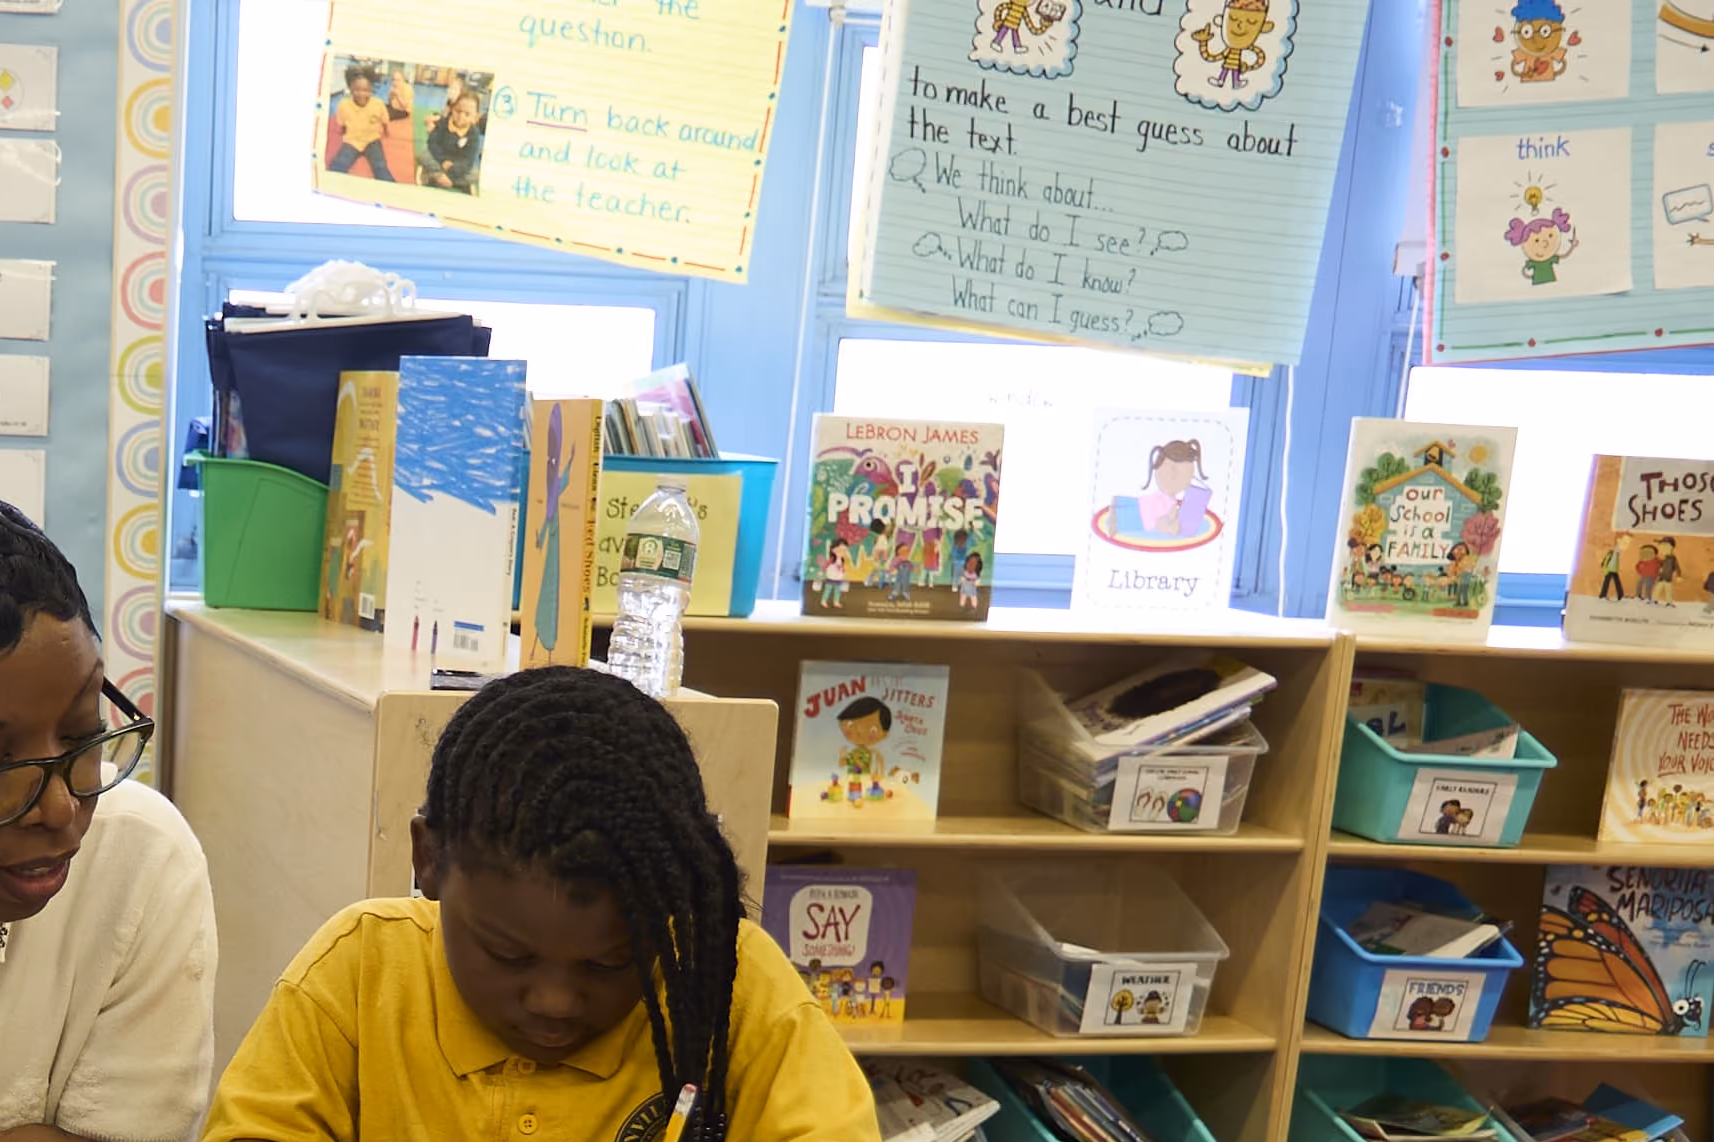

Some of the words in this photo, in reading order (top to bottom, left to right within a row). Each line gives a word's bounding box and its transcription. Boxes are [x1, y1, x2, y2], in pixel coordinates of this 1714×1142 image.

[527, 89, 588, 125] Turn
[607, 105, 670, 137] back
[678, 122, 759, 153] around
[908, 65, 938, 100] to
[946, 82, 1009, 115] make
[1033, 101, 1049, 121] a
[1067, 92, 1121, 134] best
[1137, 117, 1204, 153] guess
[1227, 119, 1300, 157] about
[908, 106, 950, 145] the
[519, 137, 571, 165] and
[586, 146, 639, 176] look
[653, 155, 686, 182] at
[1516, 136, 1571, 160] think
[511, 175, 557, 203] the
[934, 152, 962, 190] We
[979, 160, 1029, 200] think
[958, 196, 1011, 235] What
[1029, 213, 1051, 242] do
[1063, 213, 1080, 248] I
[1096, 227, 1146, 256] see?
[955, 235, 1006, 275] What
[1015, 252, 1034, 282] do
[1051, 252, 1067, 286] I
[1082, 259, 1137, 296] know?
[952, 276, 995, 313] What
[1007, 296, 1039, 322] can
[1051, 293, 1064, 325] I
[1069, 306, 1135, 334] guess?
[922, 425, 980, 444] JAMES
[898, 464, 918, 494] I
[827, 492, 985, 531] PROMISE
[1389, 494, 1452, 524] School
[1628, 493, 1704, 528] SHOES
[1403, 525, 1417, 537] is
[1422, 527, 1434, 539] a
[1386, 540, 1451, 562] FAMILY
[1106, 569, 1202, 596] Library
[804, 675, 867, 719] JUAN
[1668, 703, 1691, 725] THE
[1658, 752, 1686, 775] YOUR
[802, 902, 862, 944] SAY
[1121, 973, 1171, 986] WEATHER
[1408, 981, 1465, 996] FRIENDS
